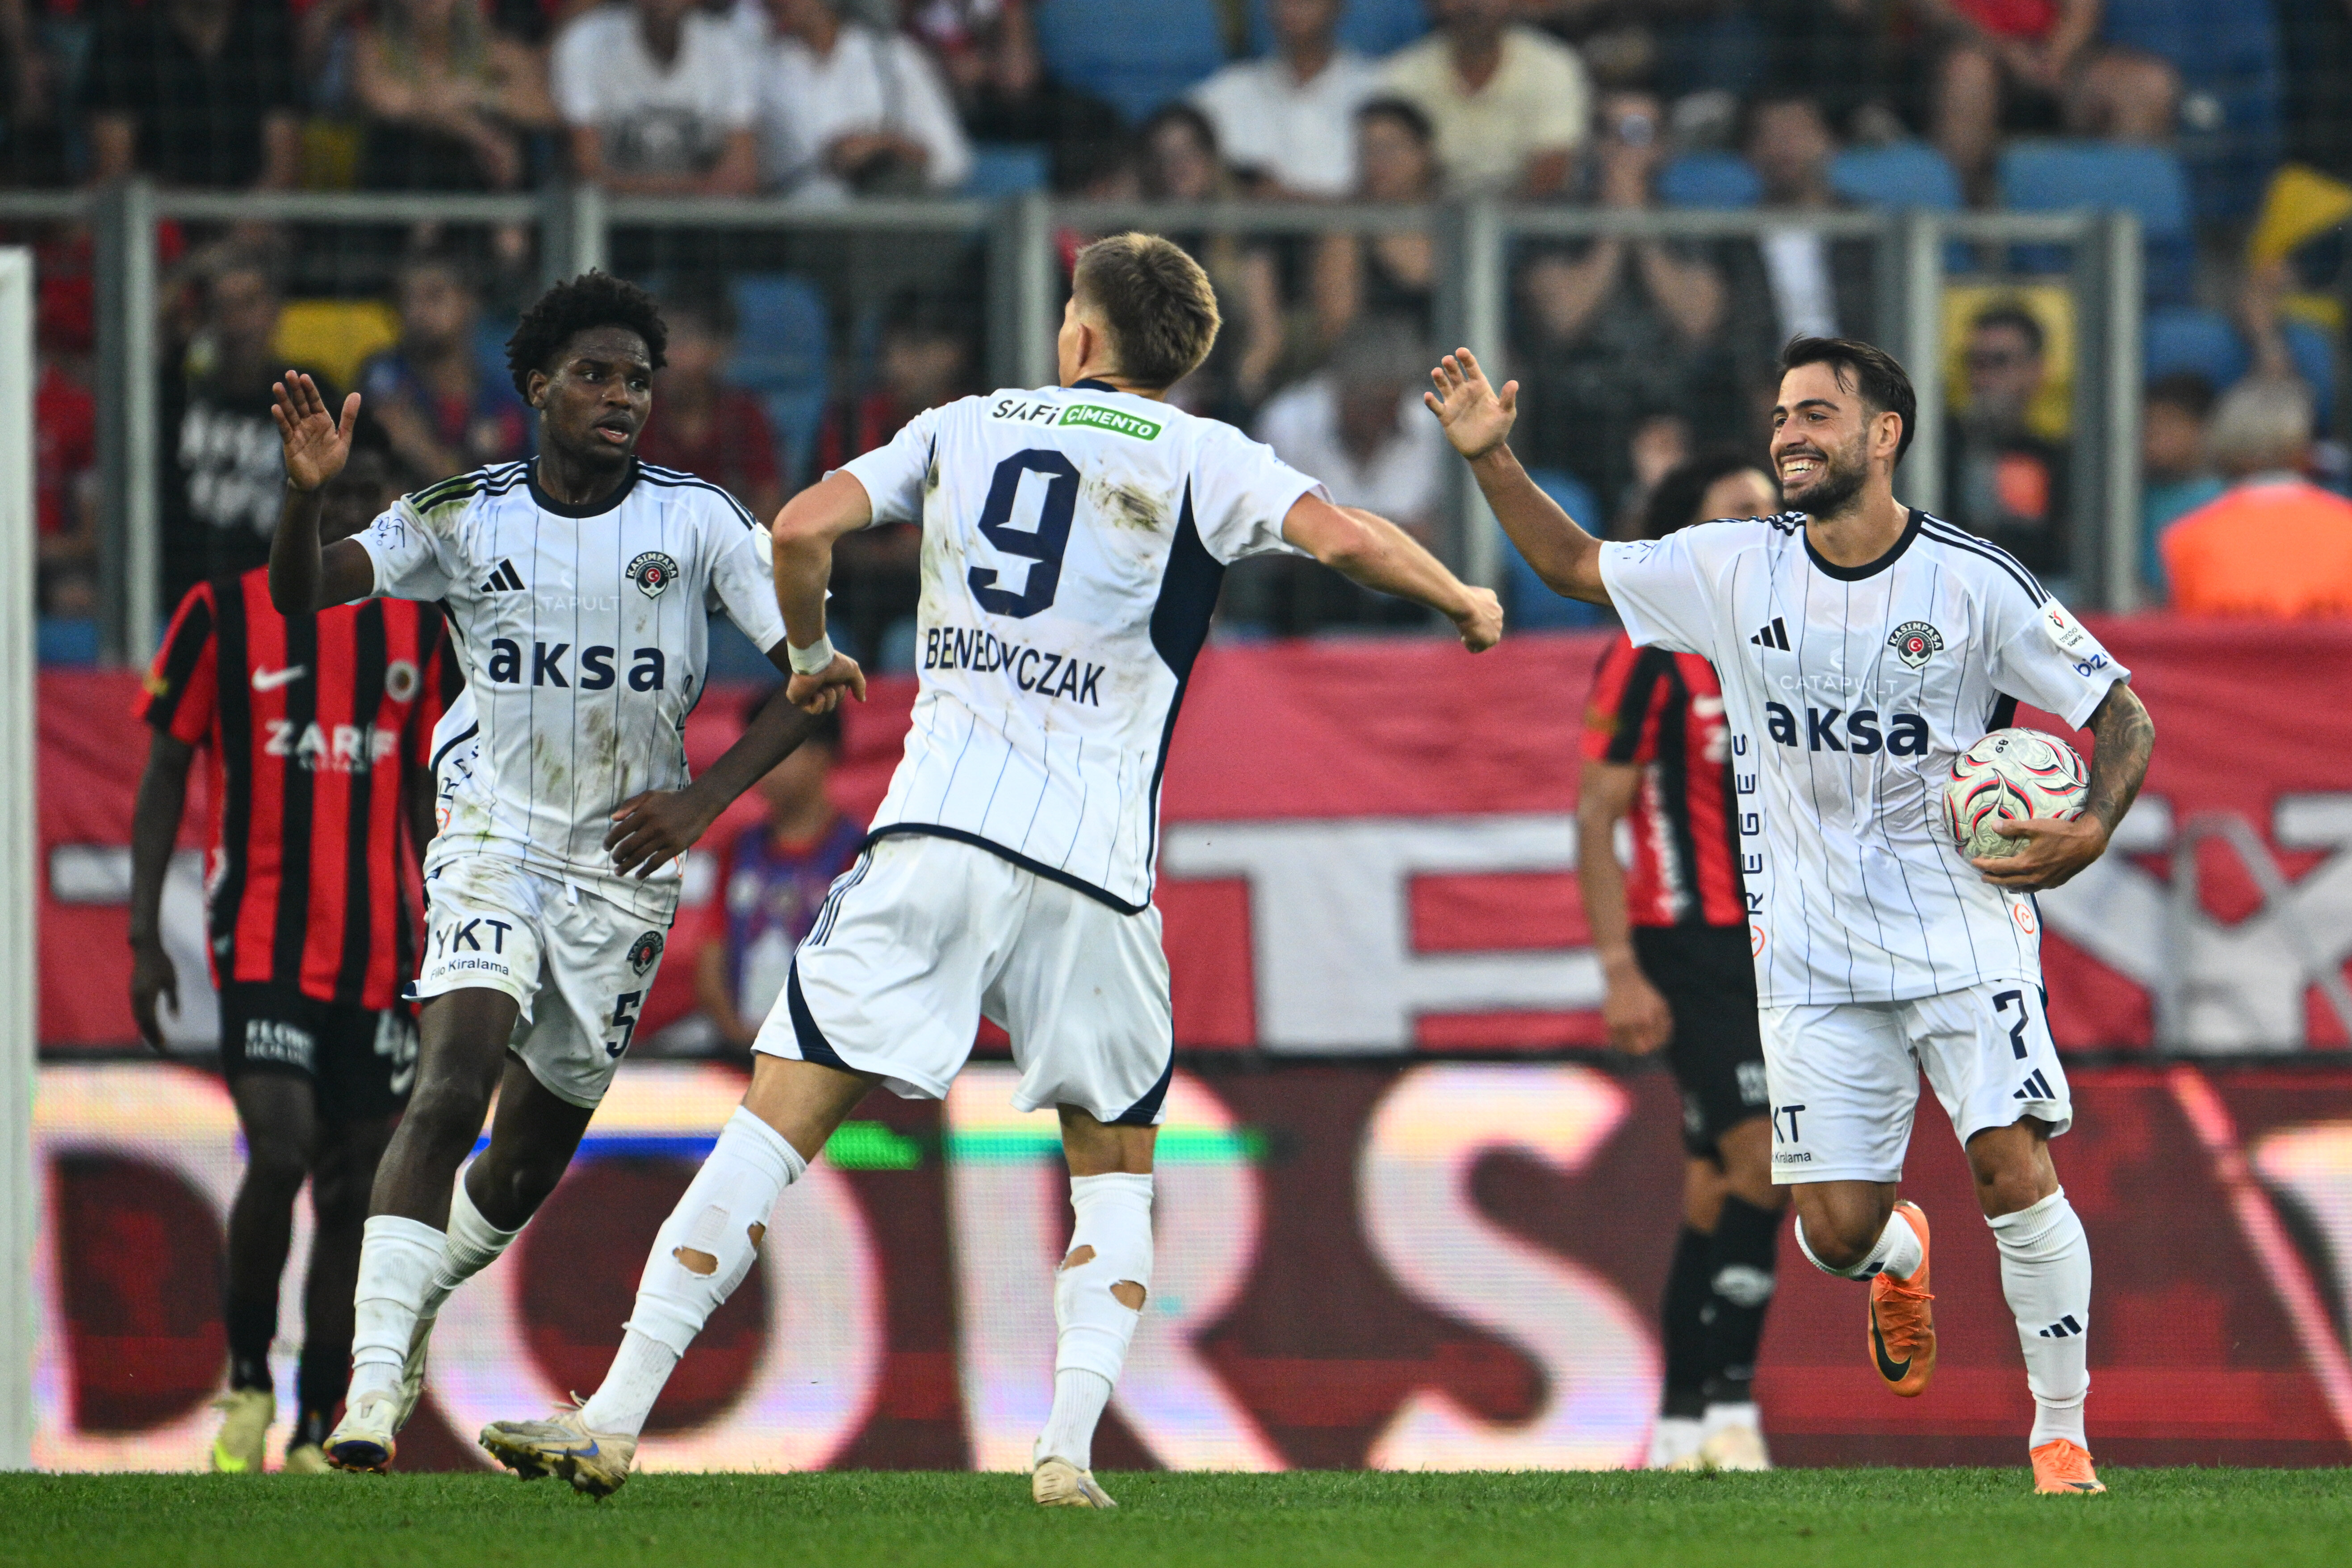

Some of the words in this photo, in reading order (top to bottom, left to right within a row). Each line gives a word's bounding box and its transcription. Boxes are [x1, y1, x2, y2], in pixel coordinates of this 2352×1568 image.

[967, 448, 1080, 619] 9
[488, 638, 665, 692] aksa
[924, 627, 1105, 707] BENEDYCZAK
[1780, 675, 1898, 694] CATAPULT
[1766, 701, 1929, 757] aksa
[436, 918, 512, 959] YKT
[448, 958, 509, 976] Kiralama
[606, 990, 641, 1058] 5
[1992, 990, 2029, 1060] 7
[1773, 1104, 1806, 1144] KT
